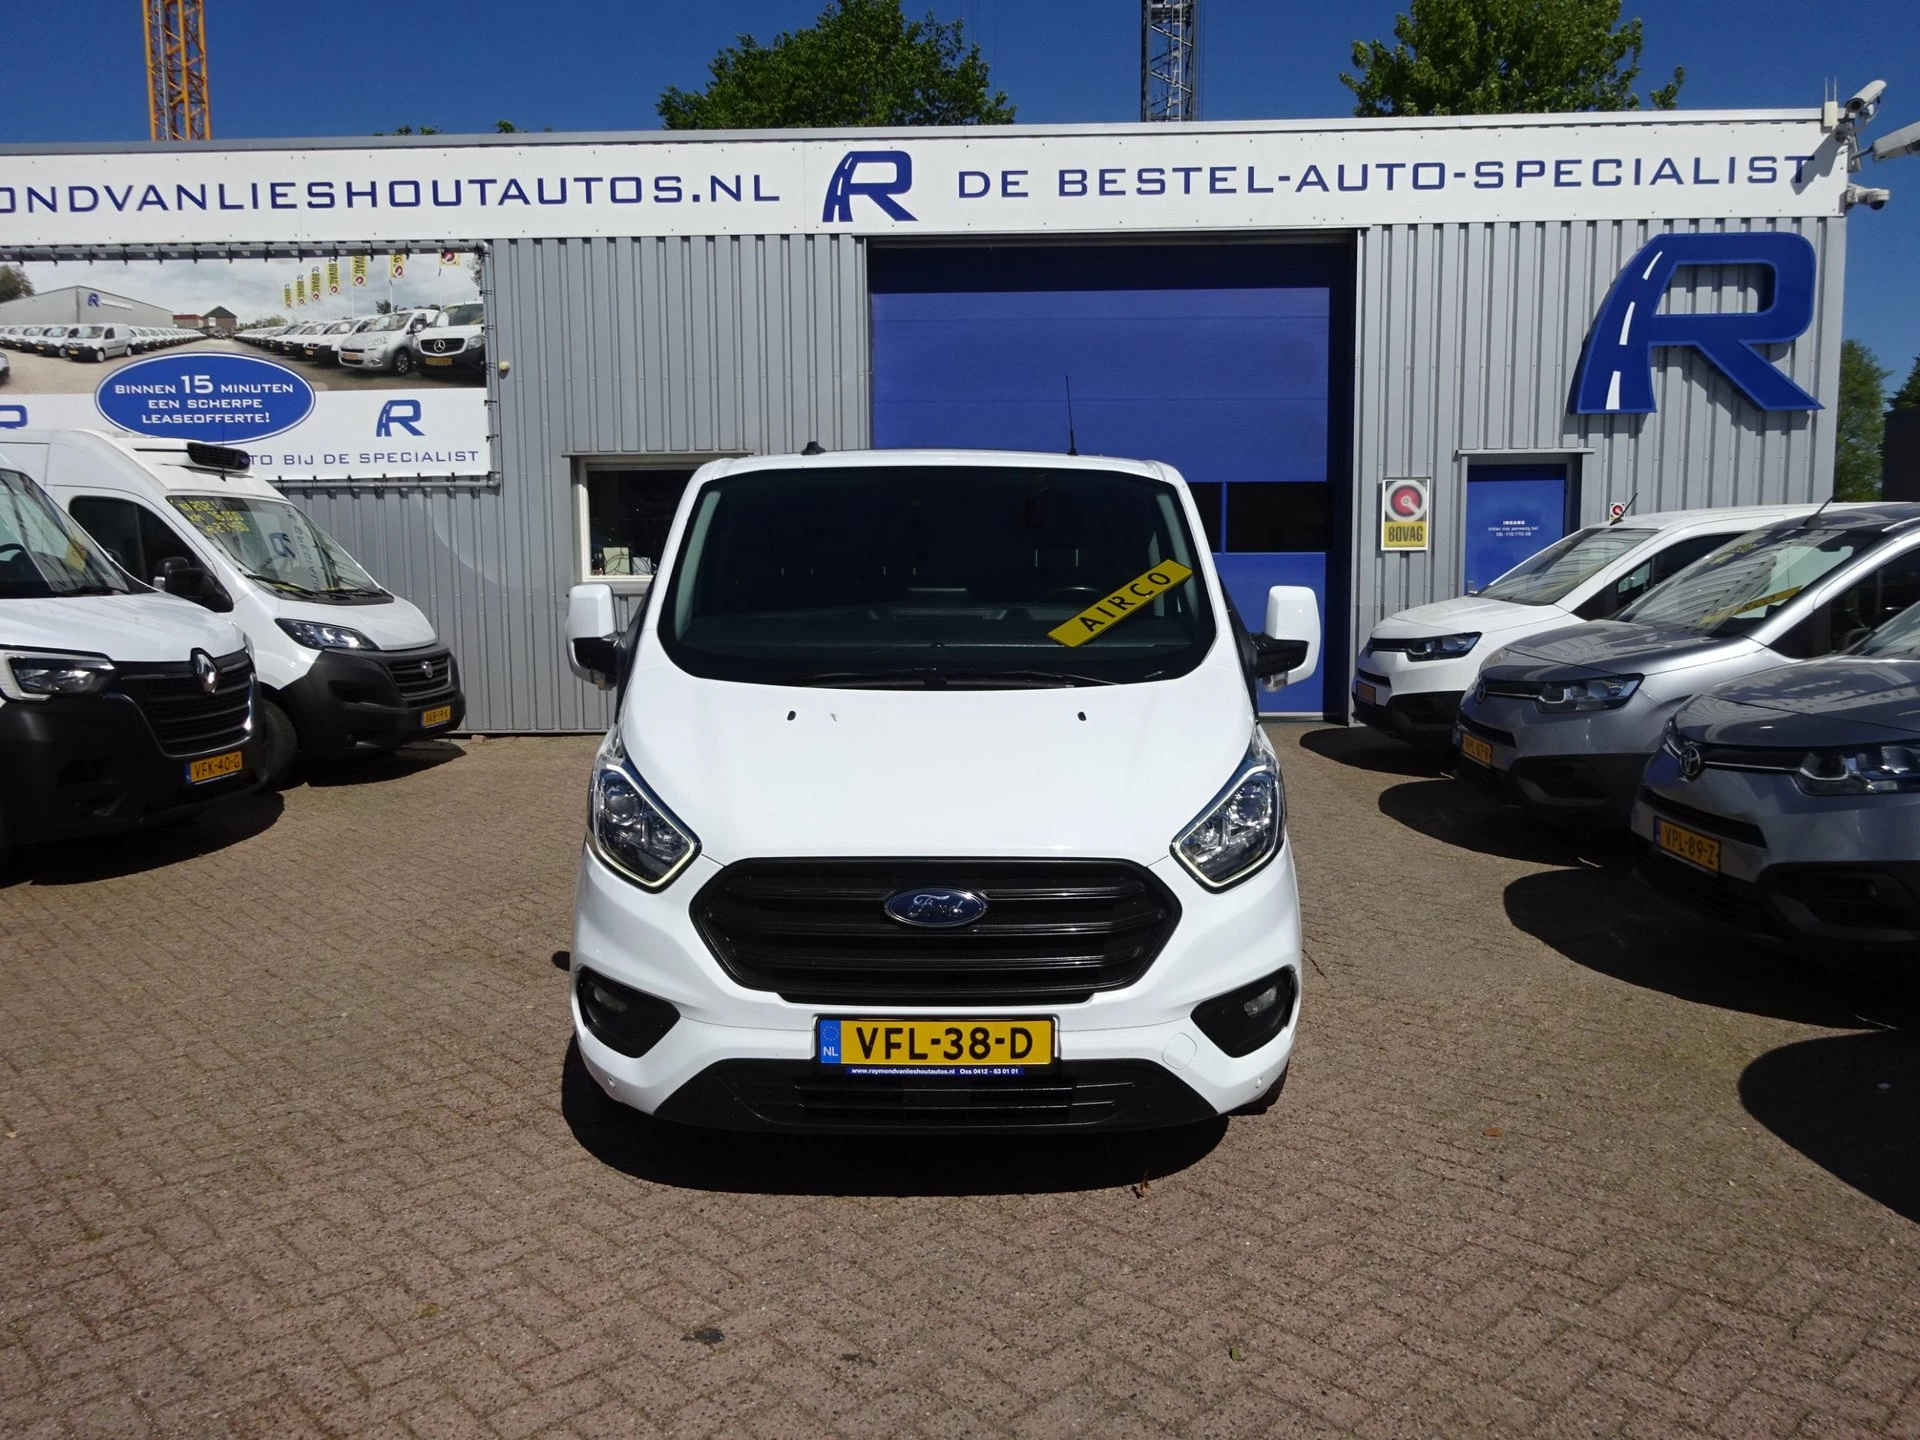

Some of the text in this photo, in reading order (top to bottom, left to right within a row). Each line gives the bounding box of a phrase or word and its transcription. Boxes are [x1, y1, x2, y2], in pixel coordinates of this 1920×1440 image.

[958, 156, 1816, 199] DE BESTEL-AUTO-SPECIALIST
[114, 375, 294, 394] BINNEN 15 MINUTEN
[148, 399, 263, 409] EEN SCHERPE
[142, 412, 270, 424] LEASEOFFERTE!
[283, 454, 314, 466] BIJ
[323, 453, 350, 465] DE
[359, 450, 480, 464] SPECIALIST
[1388, 525, 1424, 543] BOVAG
[1078, 572, 1172, 633] AIRCO
[193, 753, 240, 778] VFK-40-G
[1664, 824, 1715, 865] VPL-89-Z
[823, 1046, 838, 1057] NL
[855, 1026, 1033, 1061] VFL-38-D
